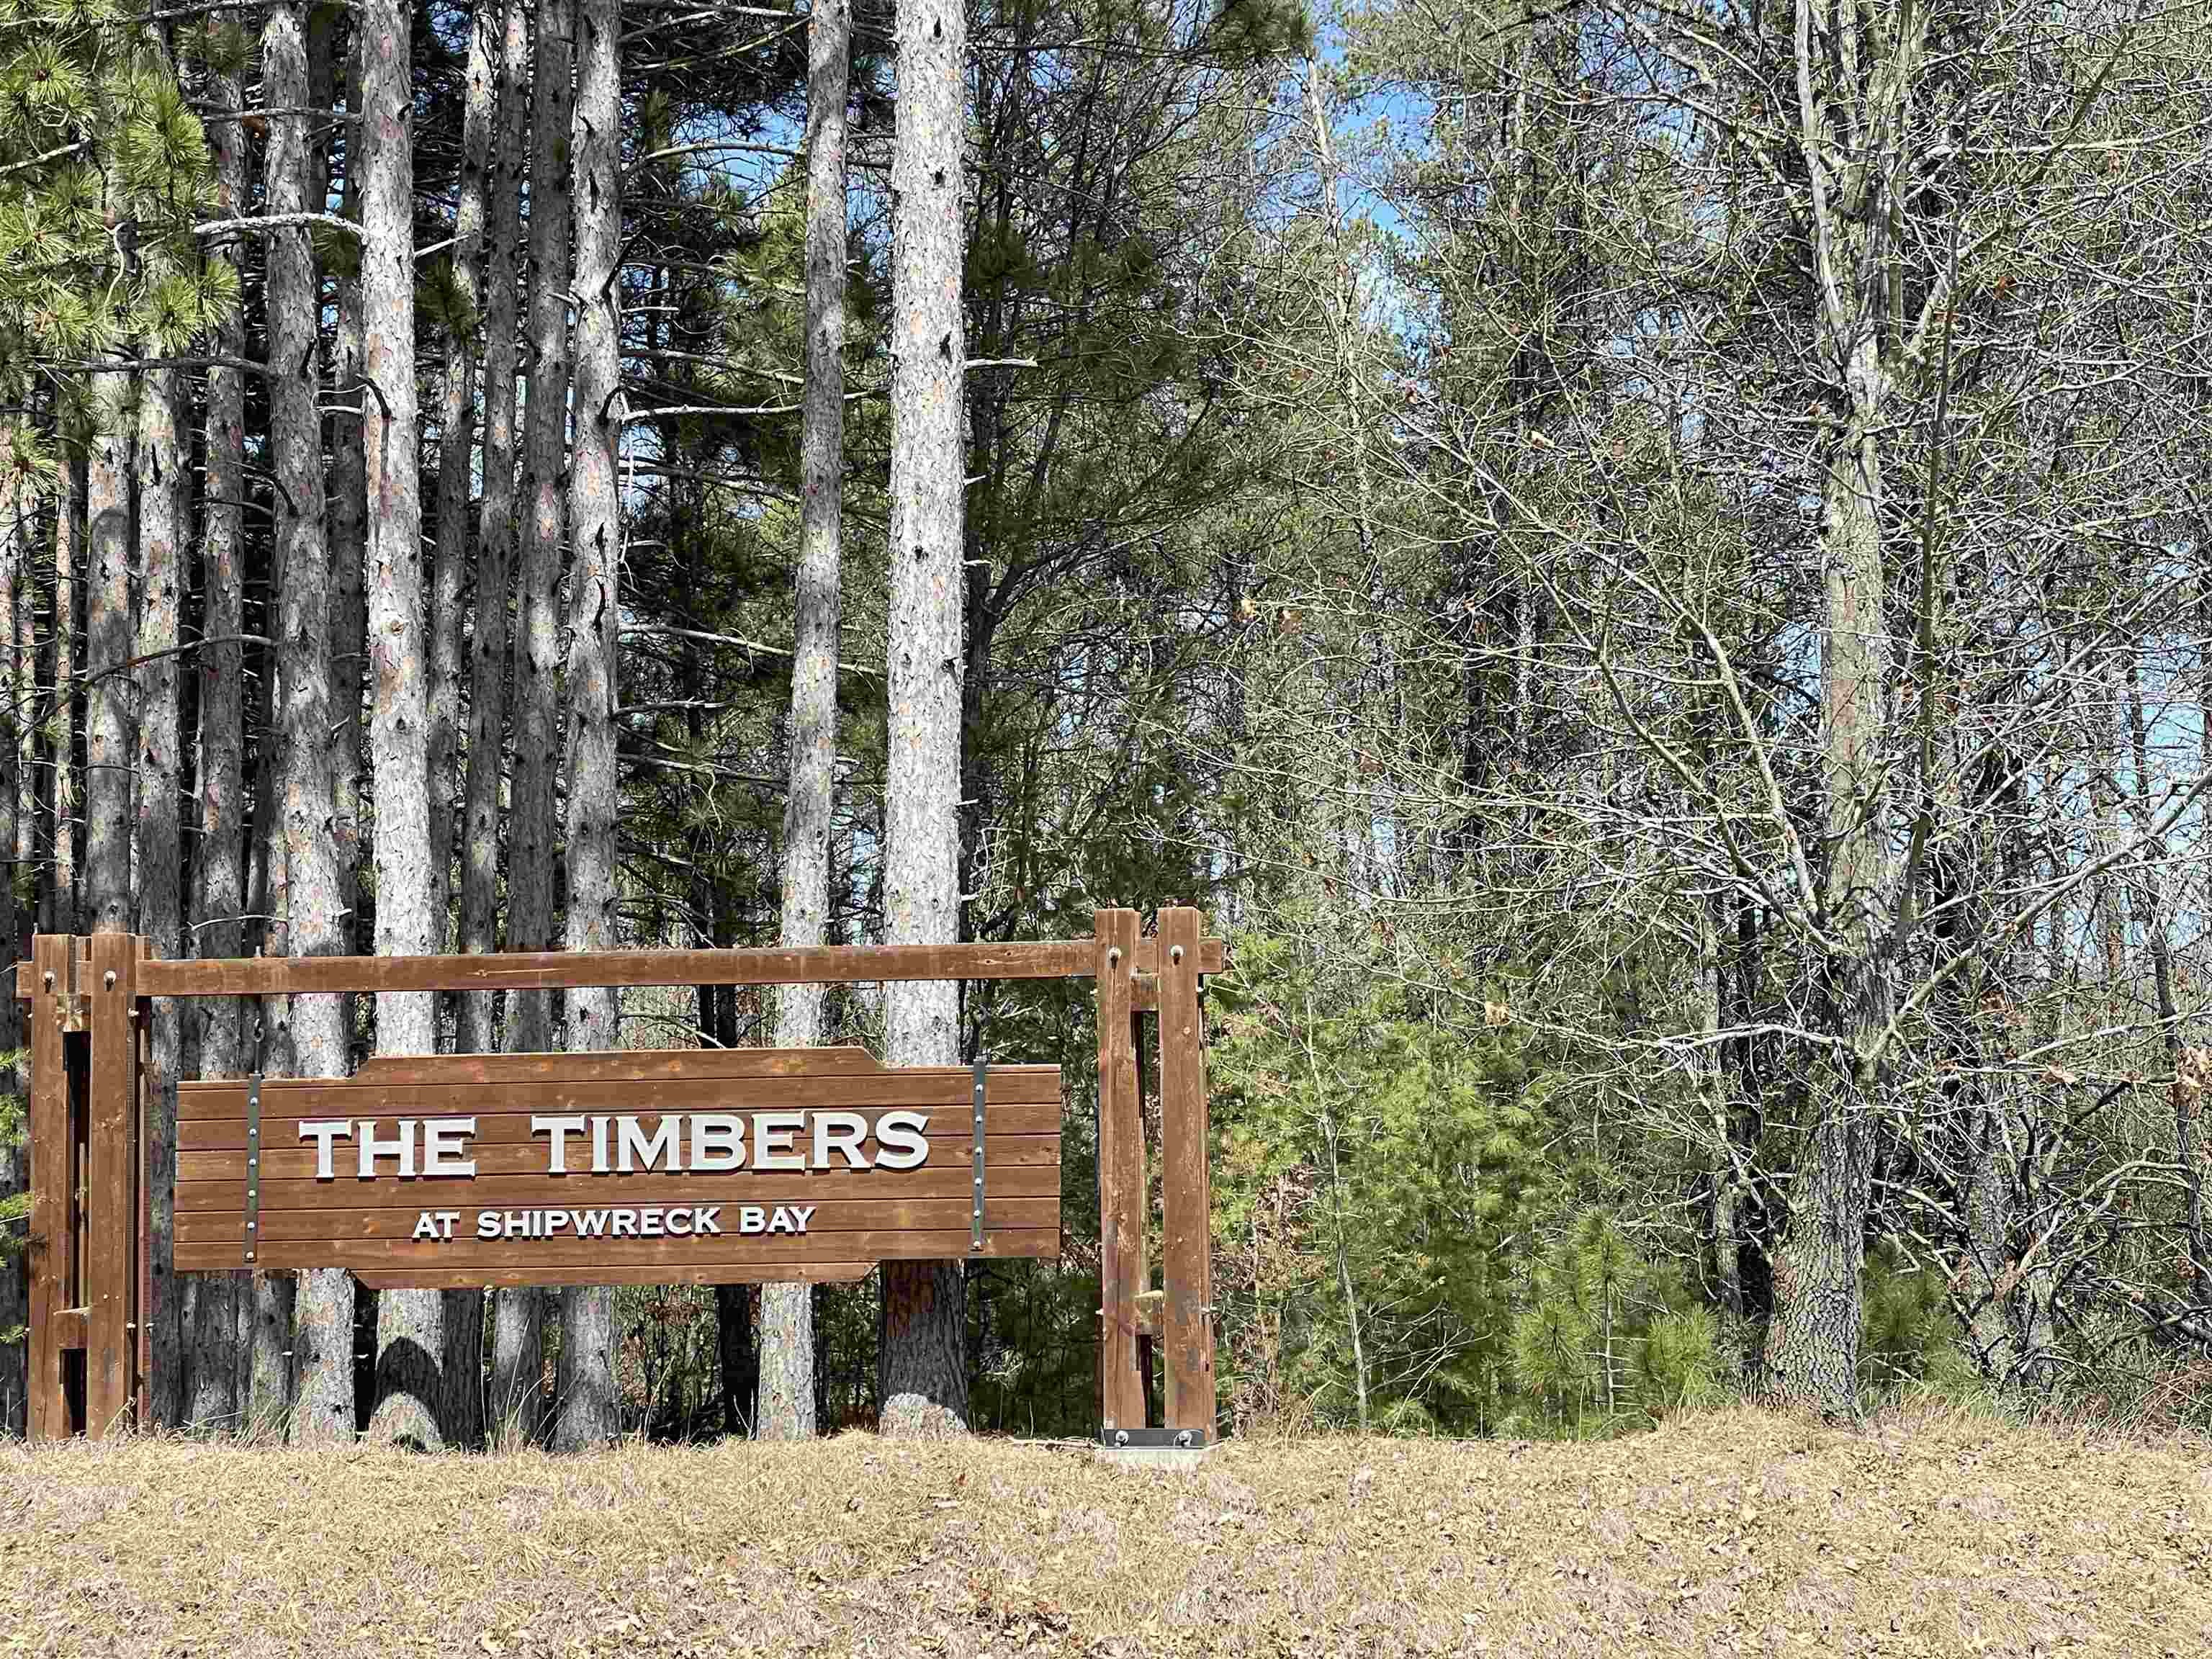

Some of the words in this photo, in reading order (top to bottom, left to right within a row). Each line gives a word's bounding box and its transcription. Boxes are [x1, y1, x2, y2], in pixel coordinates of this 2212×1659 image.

[298, 1117, 477, 1179] THE
[531, 1110, 930, 1174] TIMBERS
[411, 1211, 460, 1239] AT
[477, 1207, 721, 1238] SHIPWRECK
[739, 1206, 817, 1233] BAY
